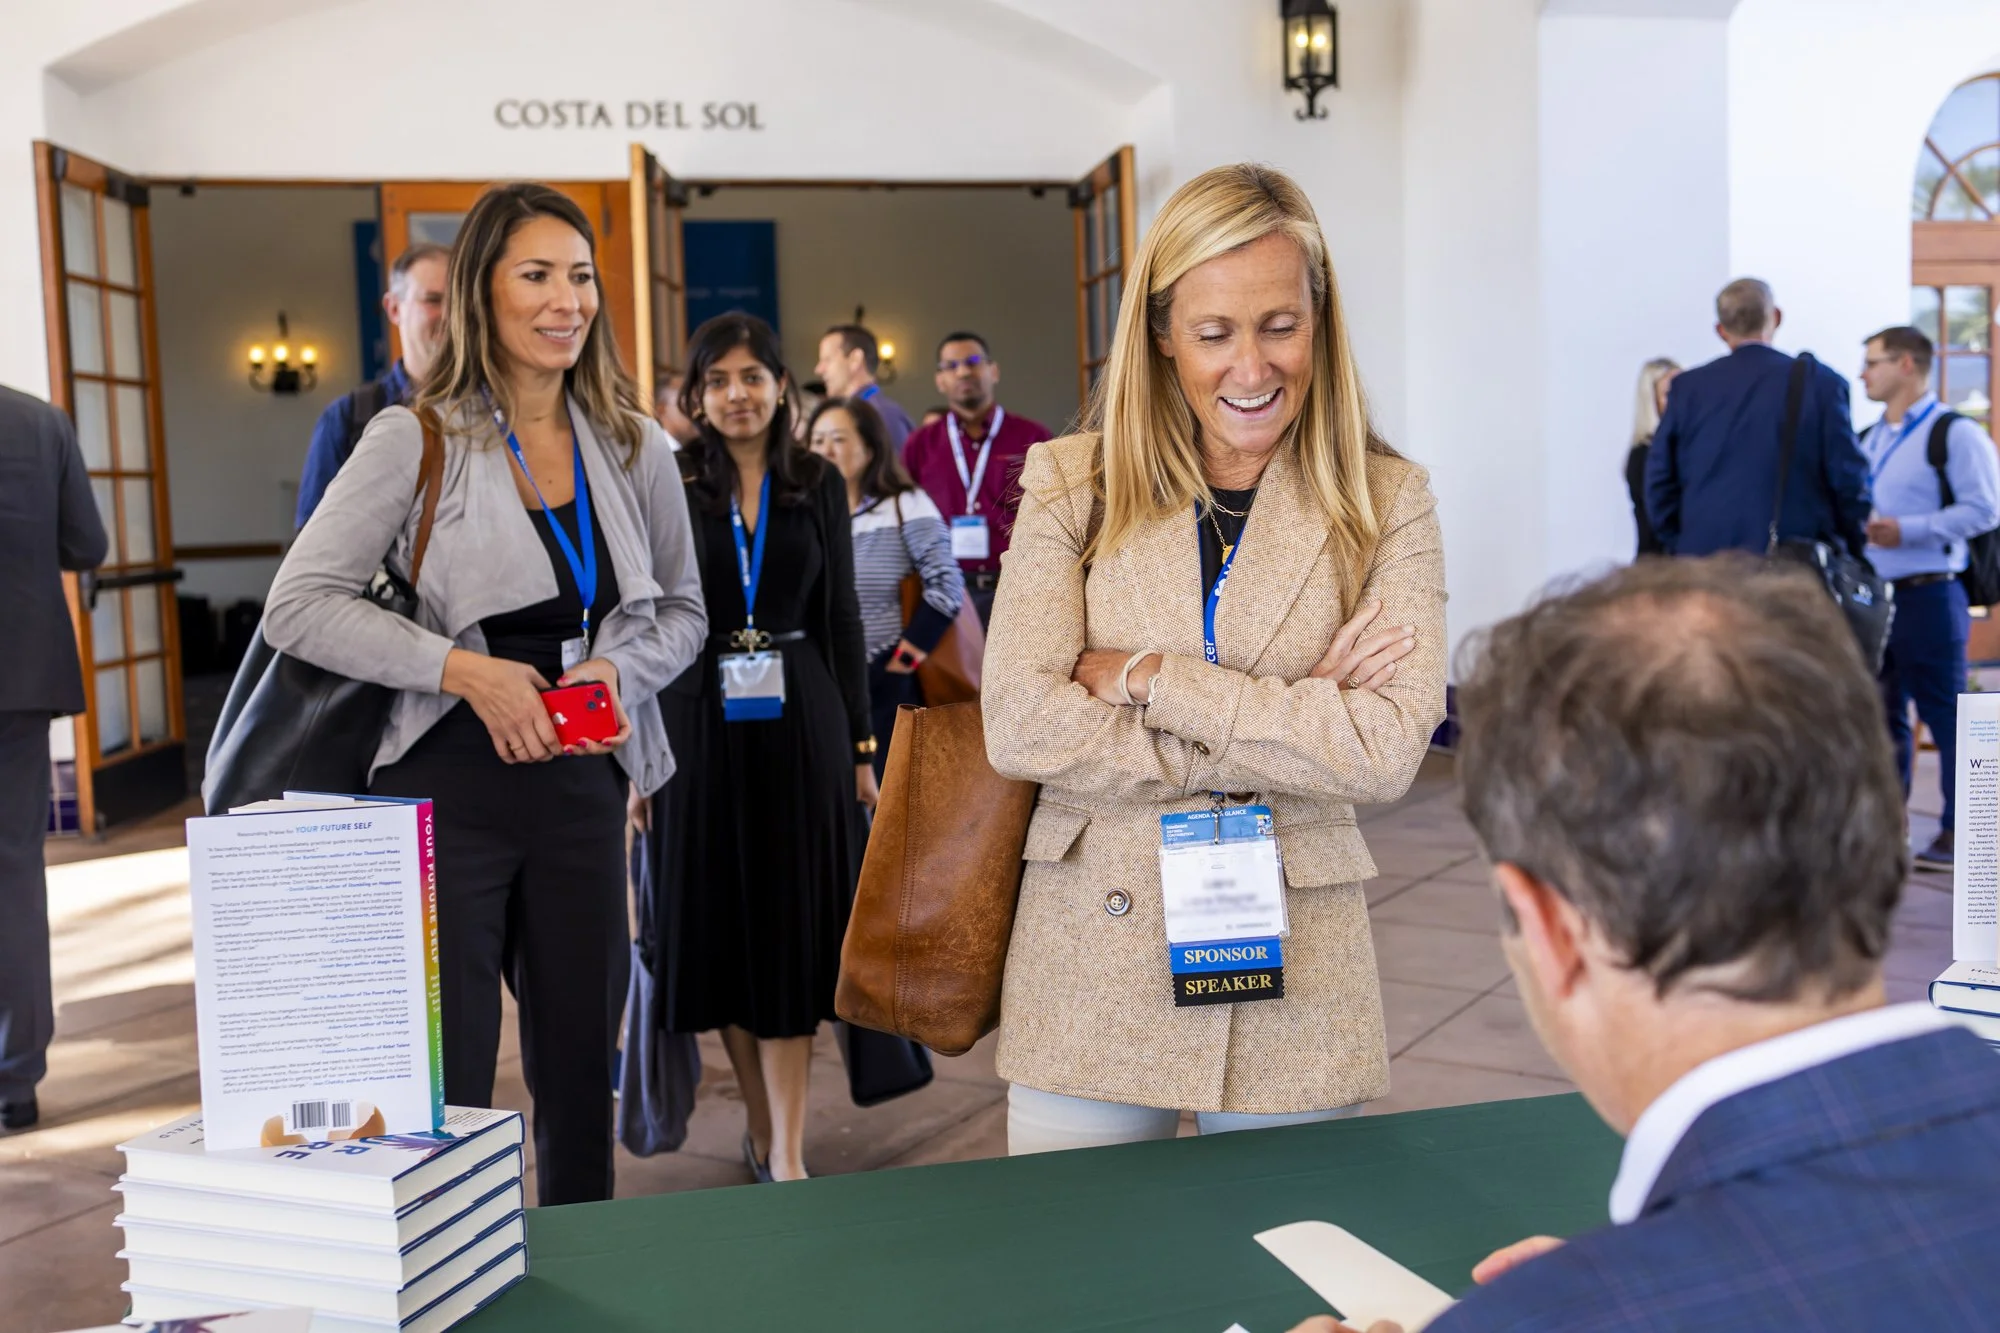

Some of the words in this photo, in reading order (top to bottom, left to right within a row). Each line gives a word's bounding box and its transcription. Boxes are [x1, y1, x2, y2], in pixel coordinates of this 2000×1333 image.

[494, 98, 613, 130] COSTA
[625, 99, 691, 130] DEL
[701, 100, 766, 131] SOL
[320, 823, 351, 831] FUTURE
[1224, 809, 1247, 817] GLANCE
[424, 813, 434, 858] YOUR
[427, 864, 437, 924] FUTURE
[430, 928, 439, 964] SELF
[1184, 946, 1268, 965] SPONSOR
[1185, 973, 1273, 996] SPEAKER
